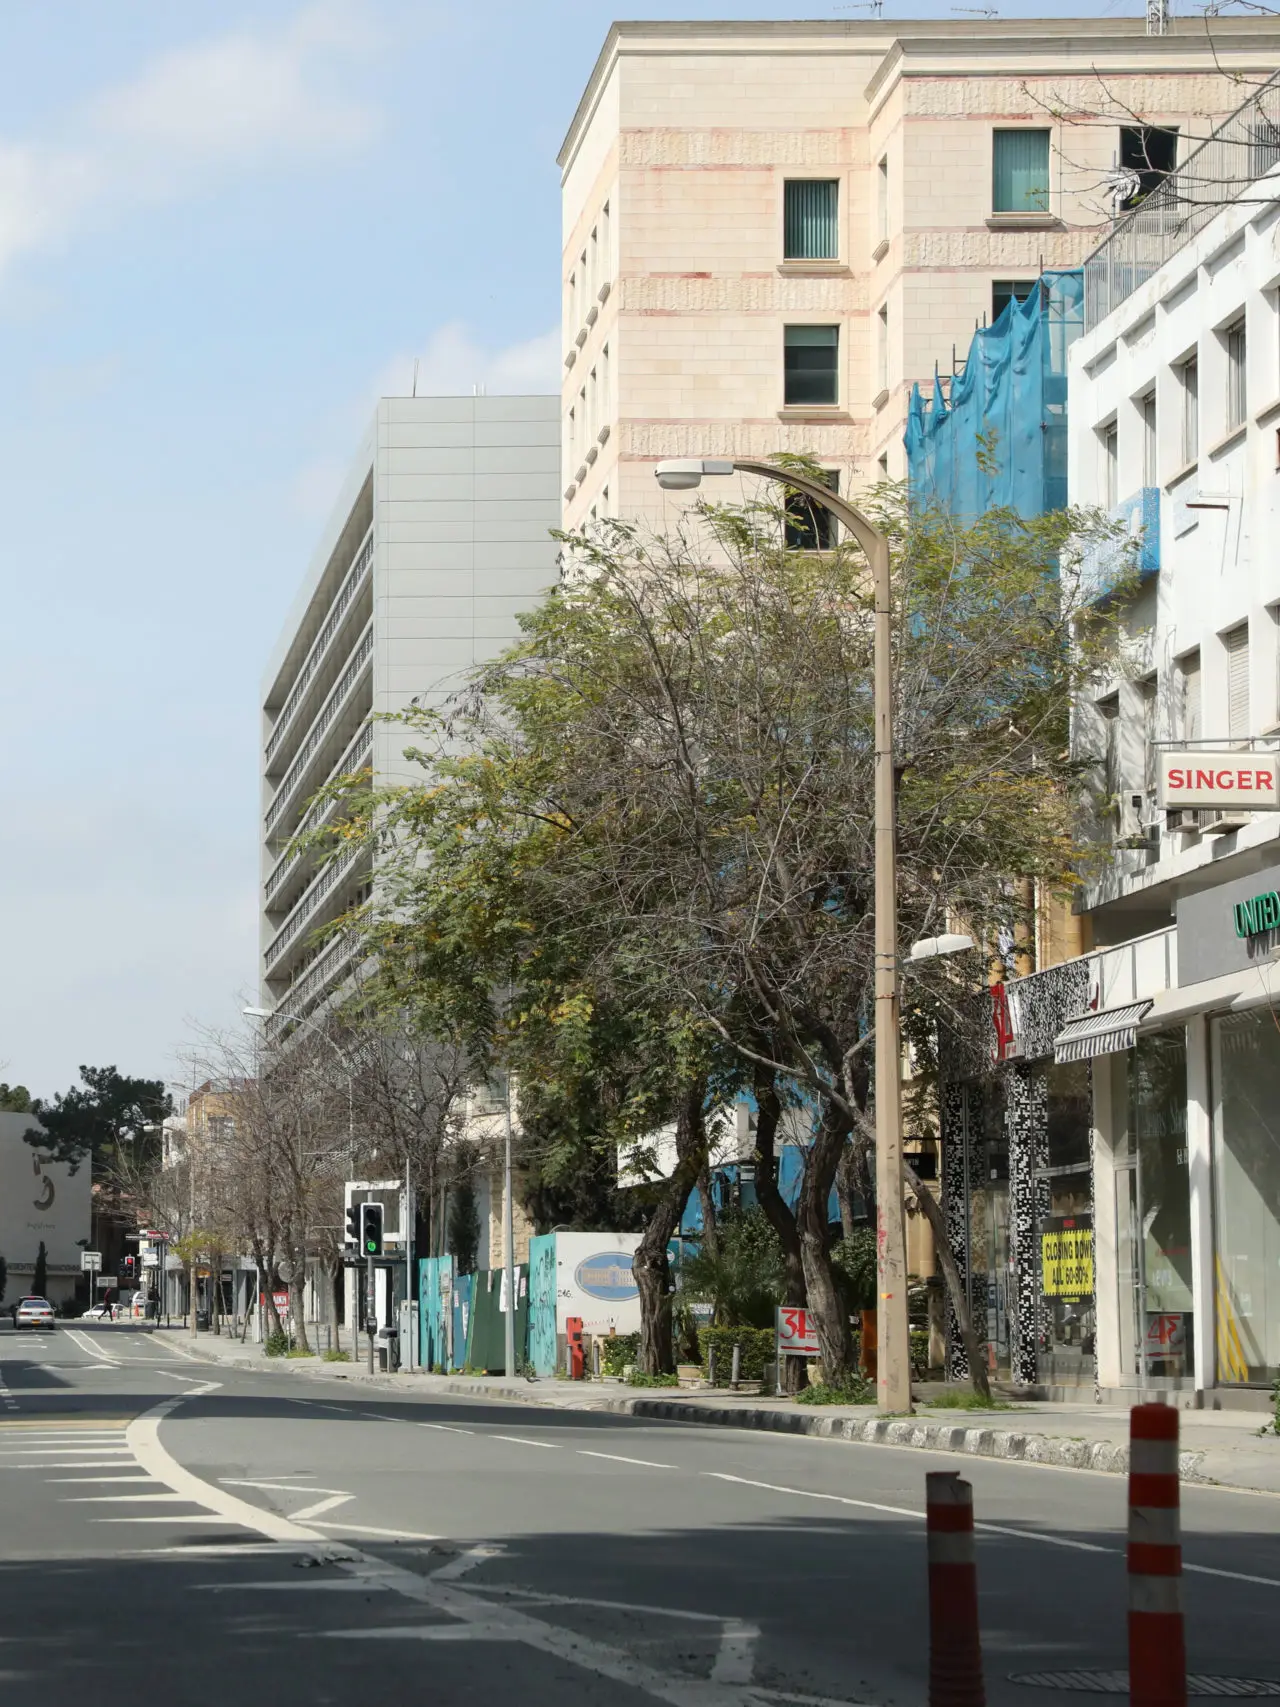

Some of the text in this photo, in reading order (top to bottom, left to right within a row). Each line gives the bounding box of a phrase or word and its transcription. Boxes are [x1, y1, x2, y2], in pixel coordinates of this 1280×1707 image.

[1167, 768, 1274, 791] SINGER
[1233, 891, 1280, 939] UNITED
[1045, 1241, 1073, 1261] CLOSING
[1052, 1266, 1064, 1285] ALL
